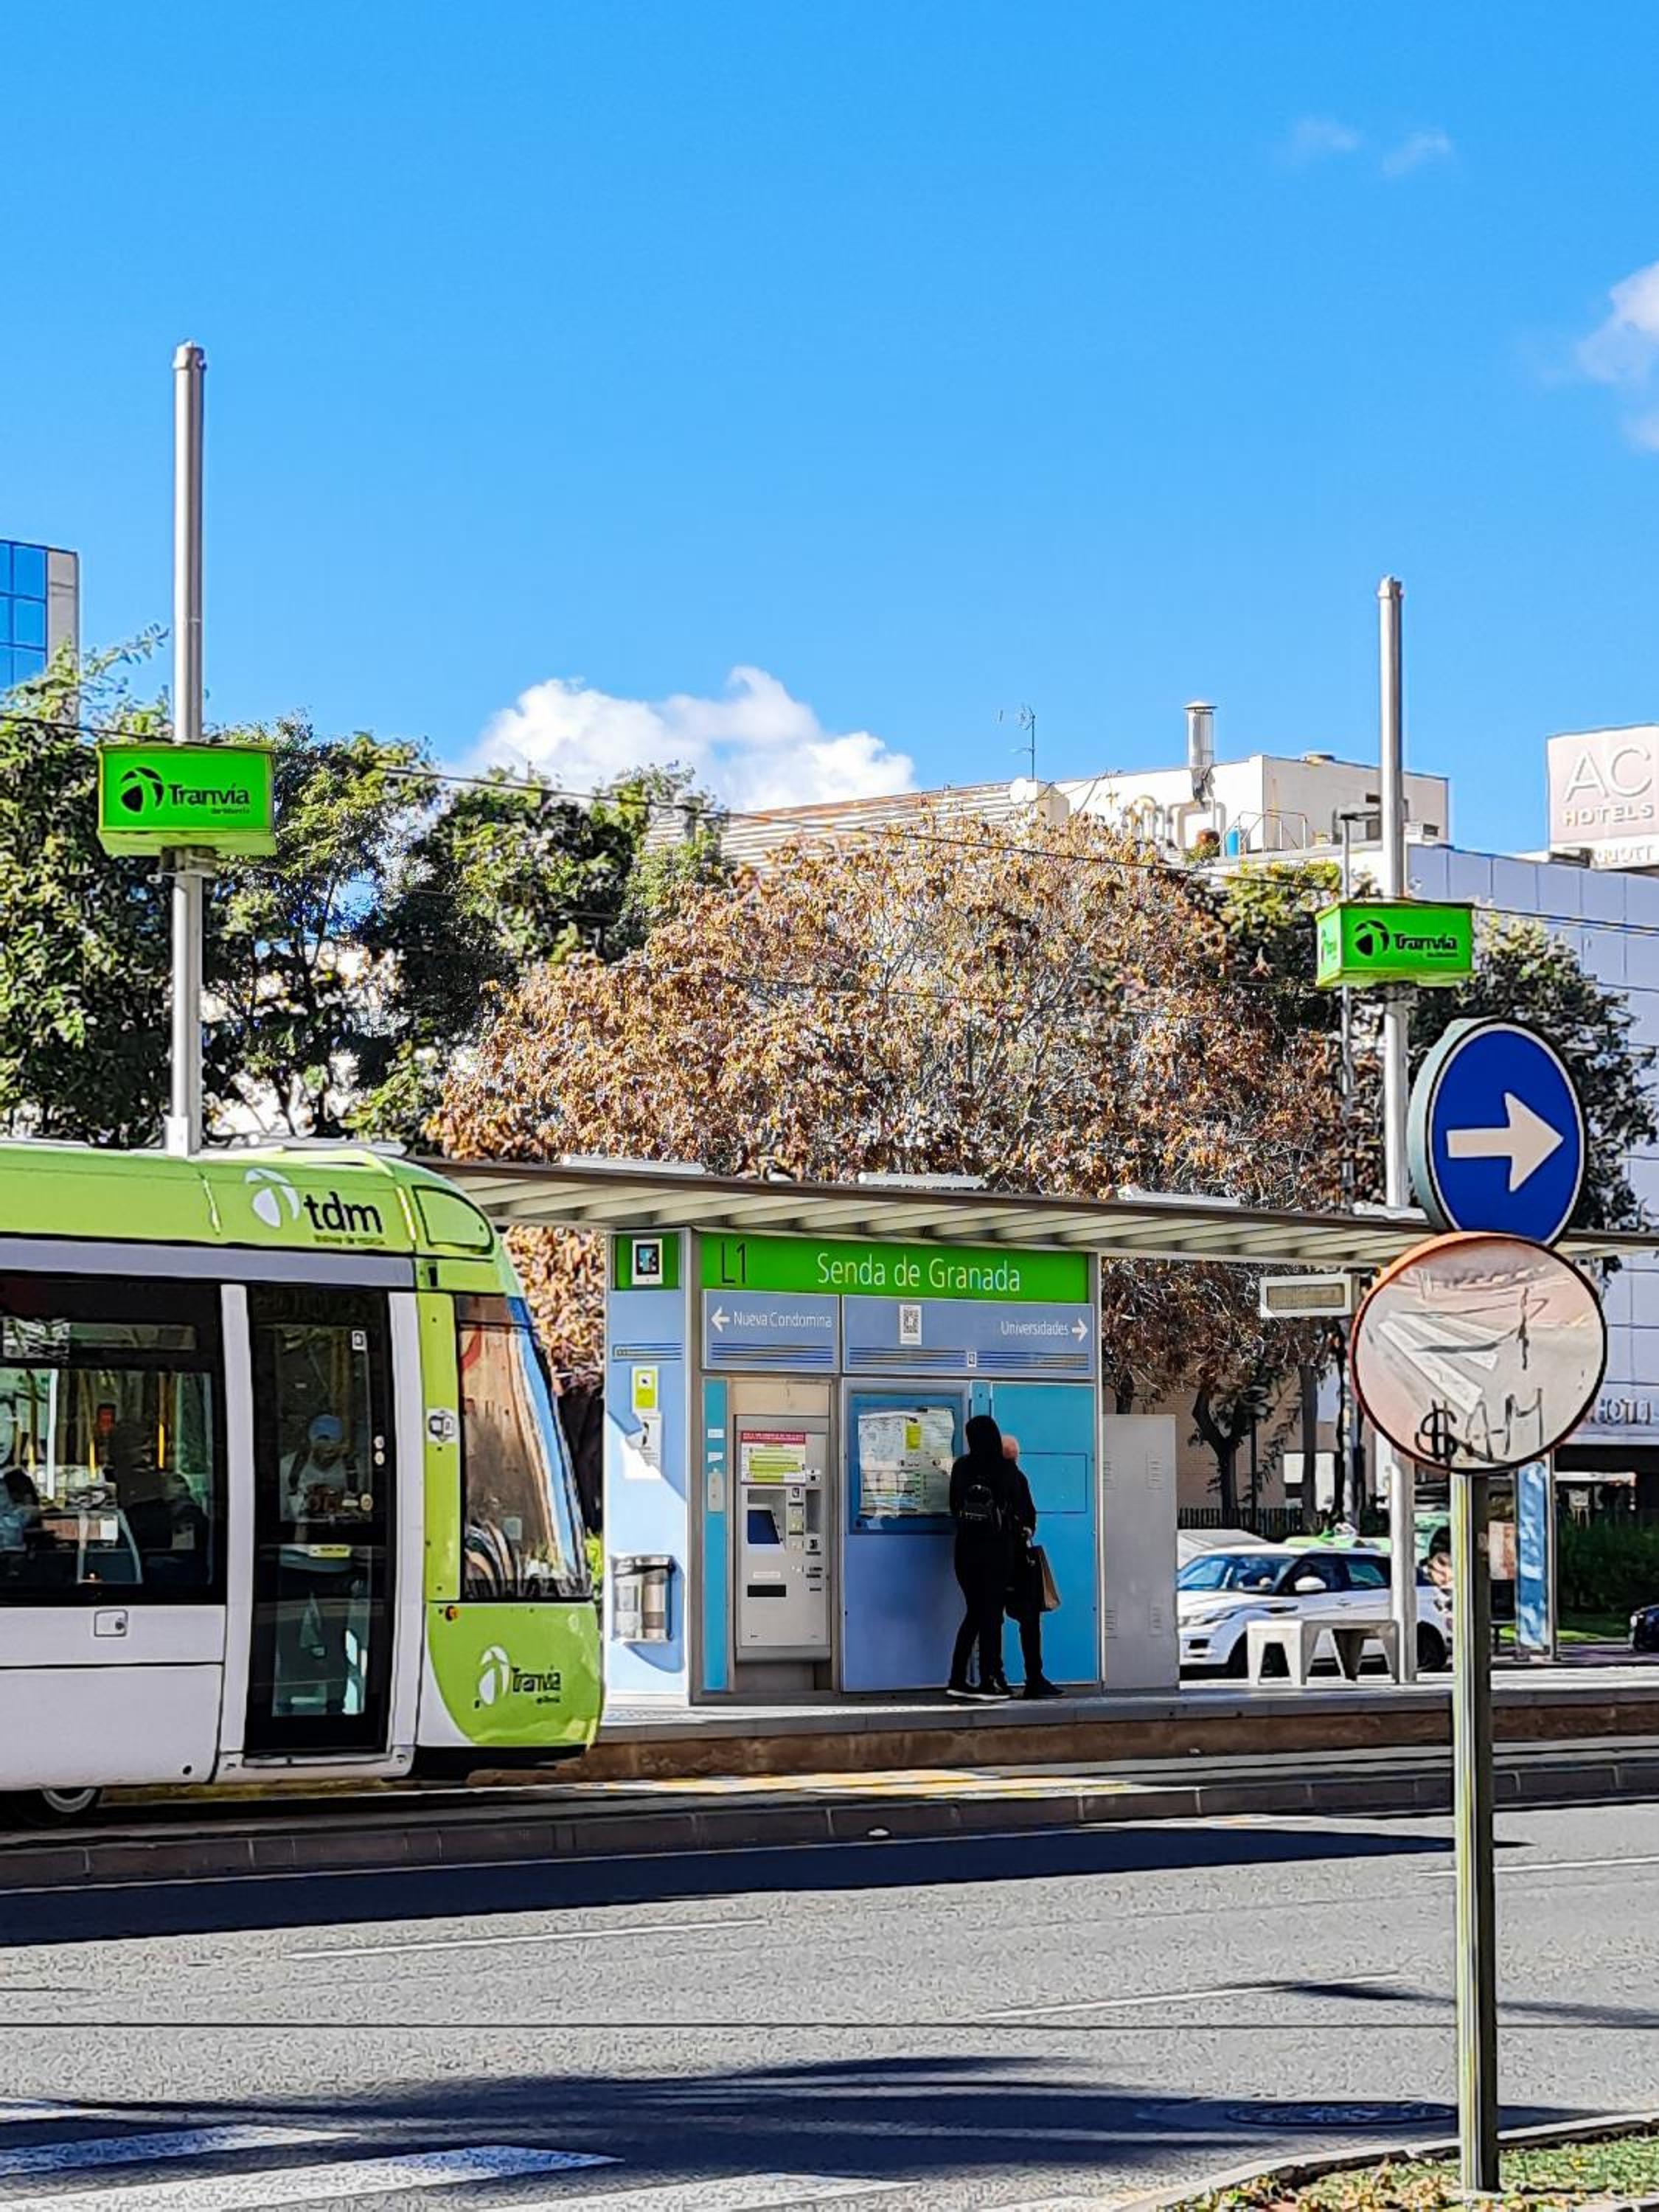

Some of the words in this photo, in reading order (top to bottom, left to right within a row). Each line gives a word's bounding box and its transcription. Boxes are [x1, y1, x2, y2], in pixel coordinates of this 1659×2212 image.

[1562, 744, 1653, 803] AC
[168, 782, 249, 806] Tranvía
[1564, 803, 1654, 827] HOTELS
[303, 1191, 383, 1234] tdm
[720, 1242, 746, 1284] L1
[817, 1253, 886, 1286] Senda
[894, 1253, 921, 1287] de
[928, 1258, 1020, 1291] Granada
[733, 1311, 768, 1326] Nueva
[770, 1311, 833, 1328] Condomina
[1000, 1321, 1069, 1336] Universidades
